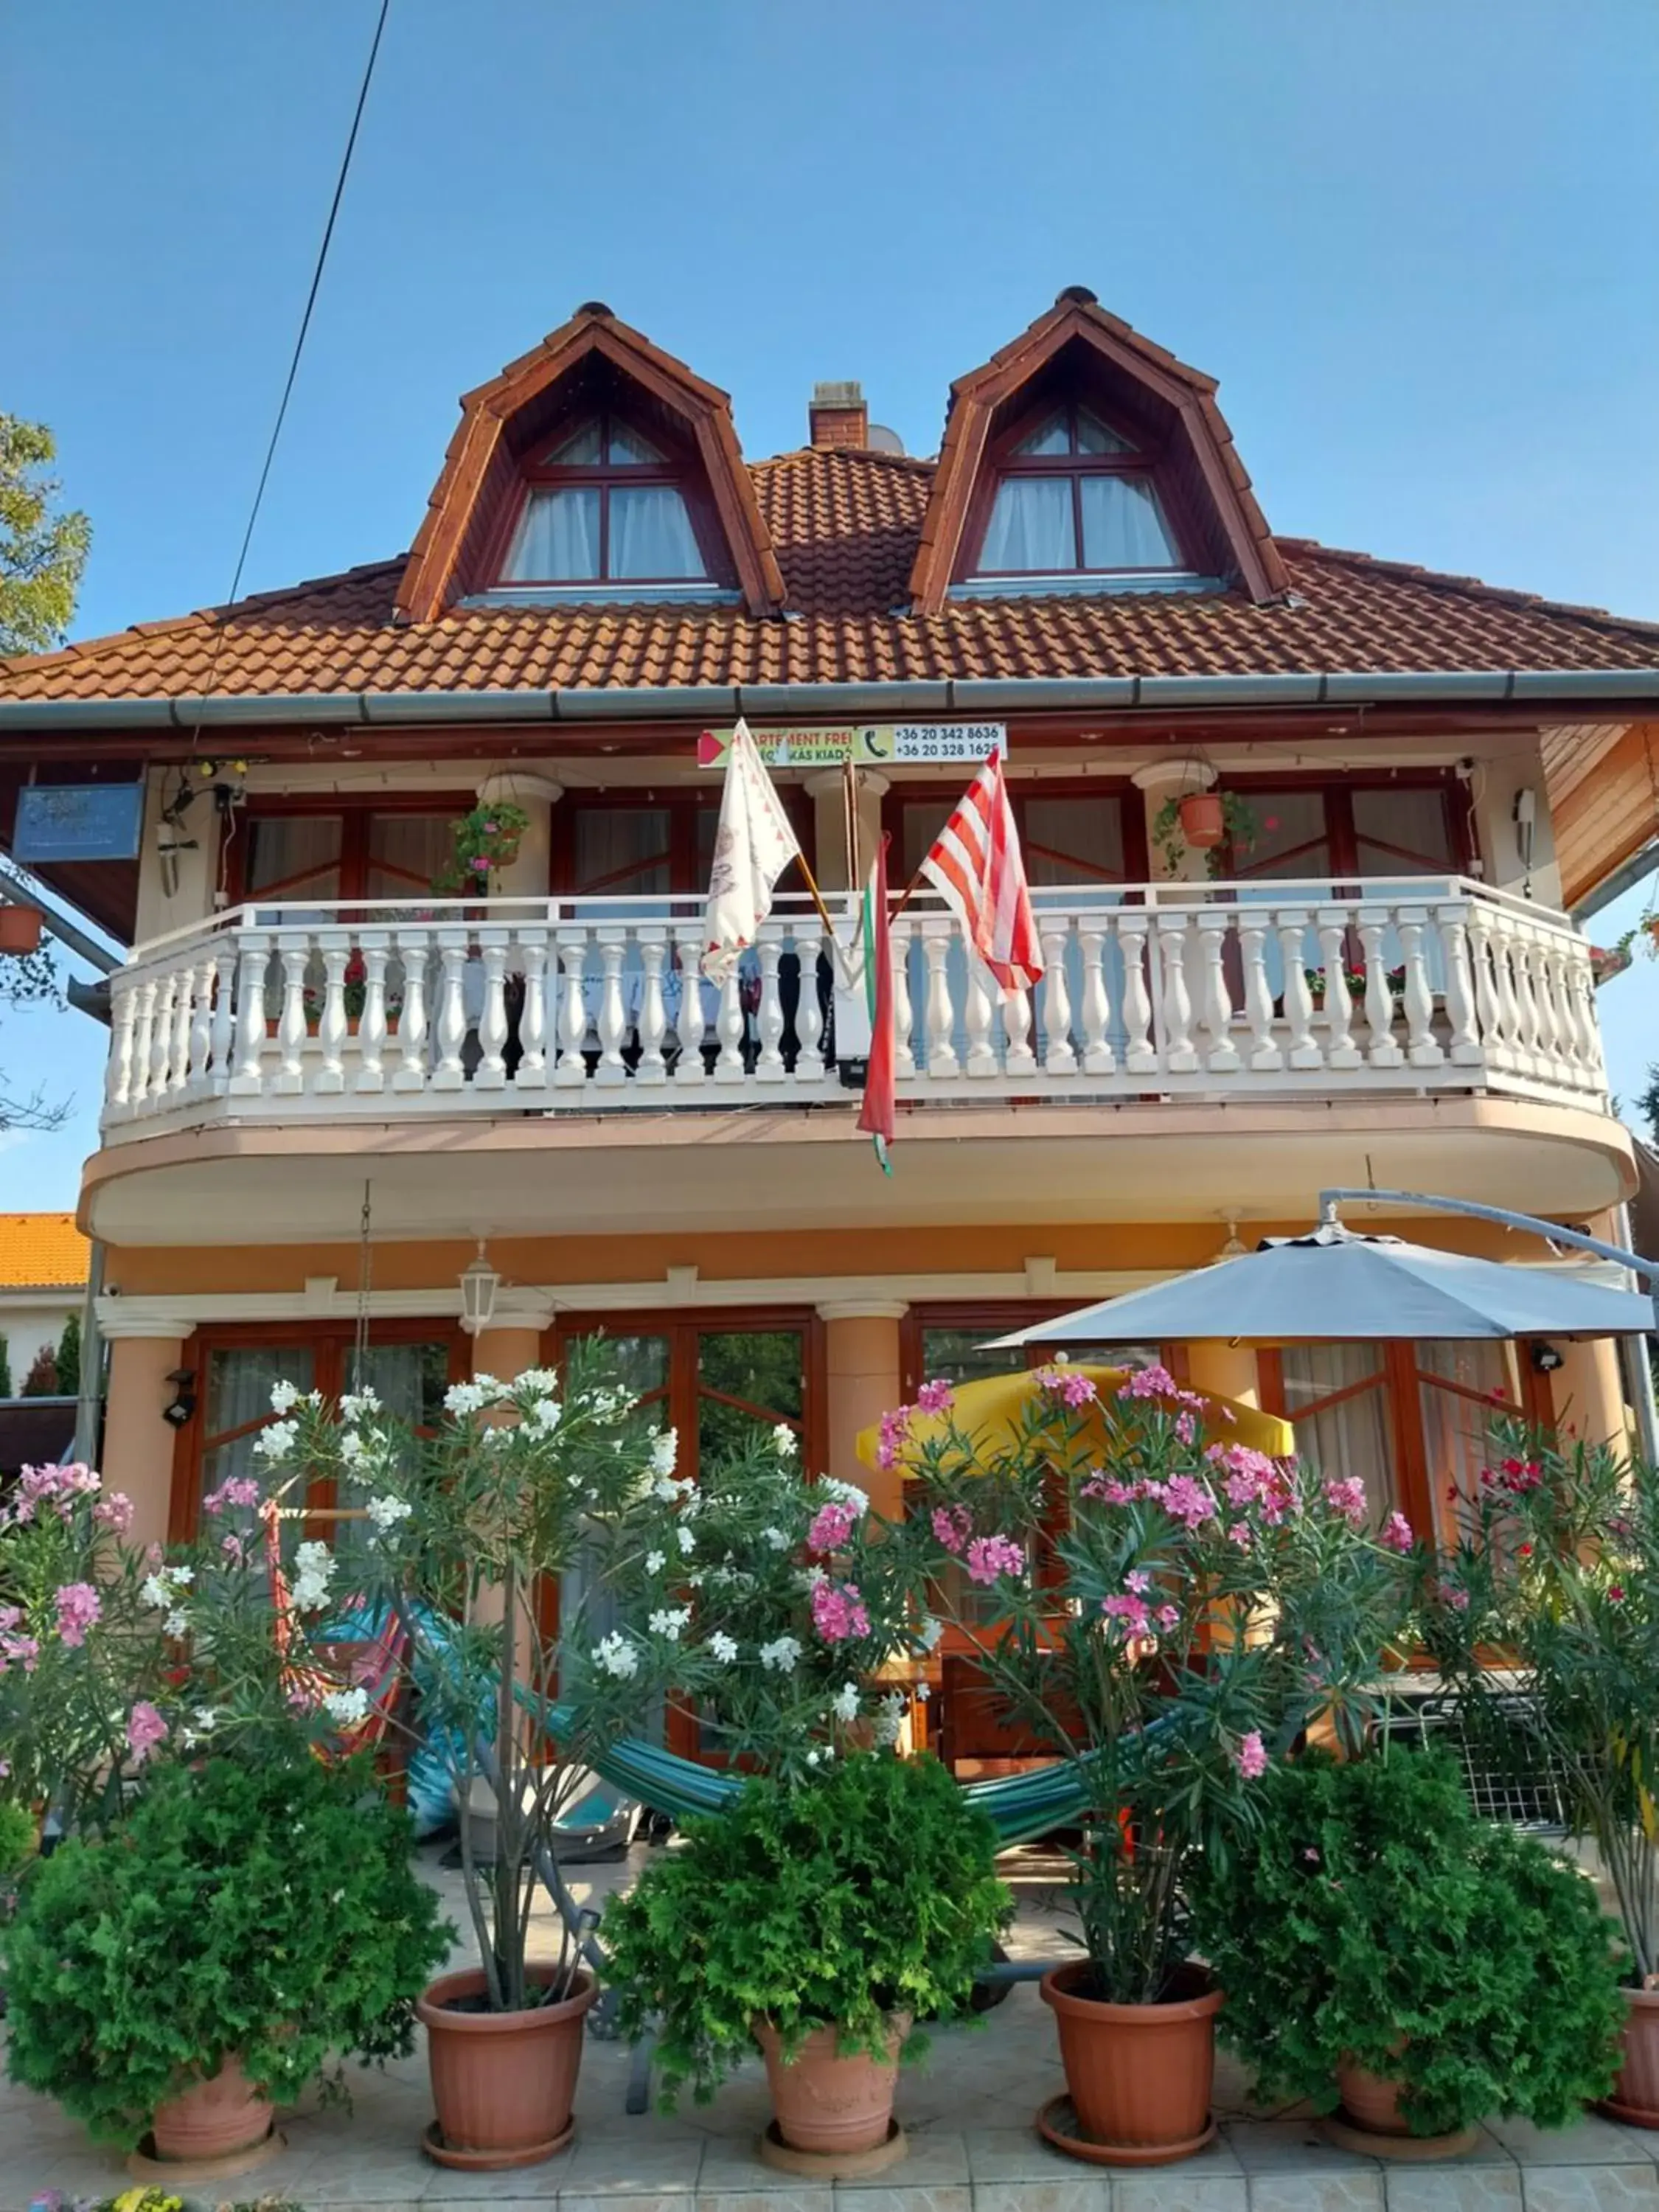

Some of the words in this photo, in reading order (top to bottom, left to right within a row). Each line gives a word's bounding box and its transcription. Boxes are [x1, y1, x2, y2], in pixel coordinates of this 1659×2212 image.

[824, 731, 852, 745] FREI
[896, 728, 918, 740] +36
[922, 728, 937, 740] 20
[941, 728, 964, 740] 342
[967, 726, 998, 738] 8636
[897, 745, 919, 756] +36
[922, 744, 938, 756] 20
[942, 744, 964, 756] 328
